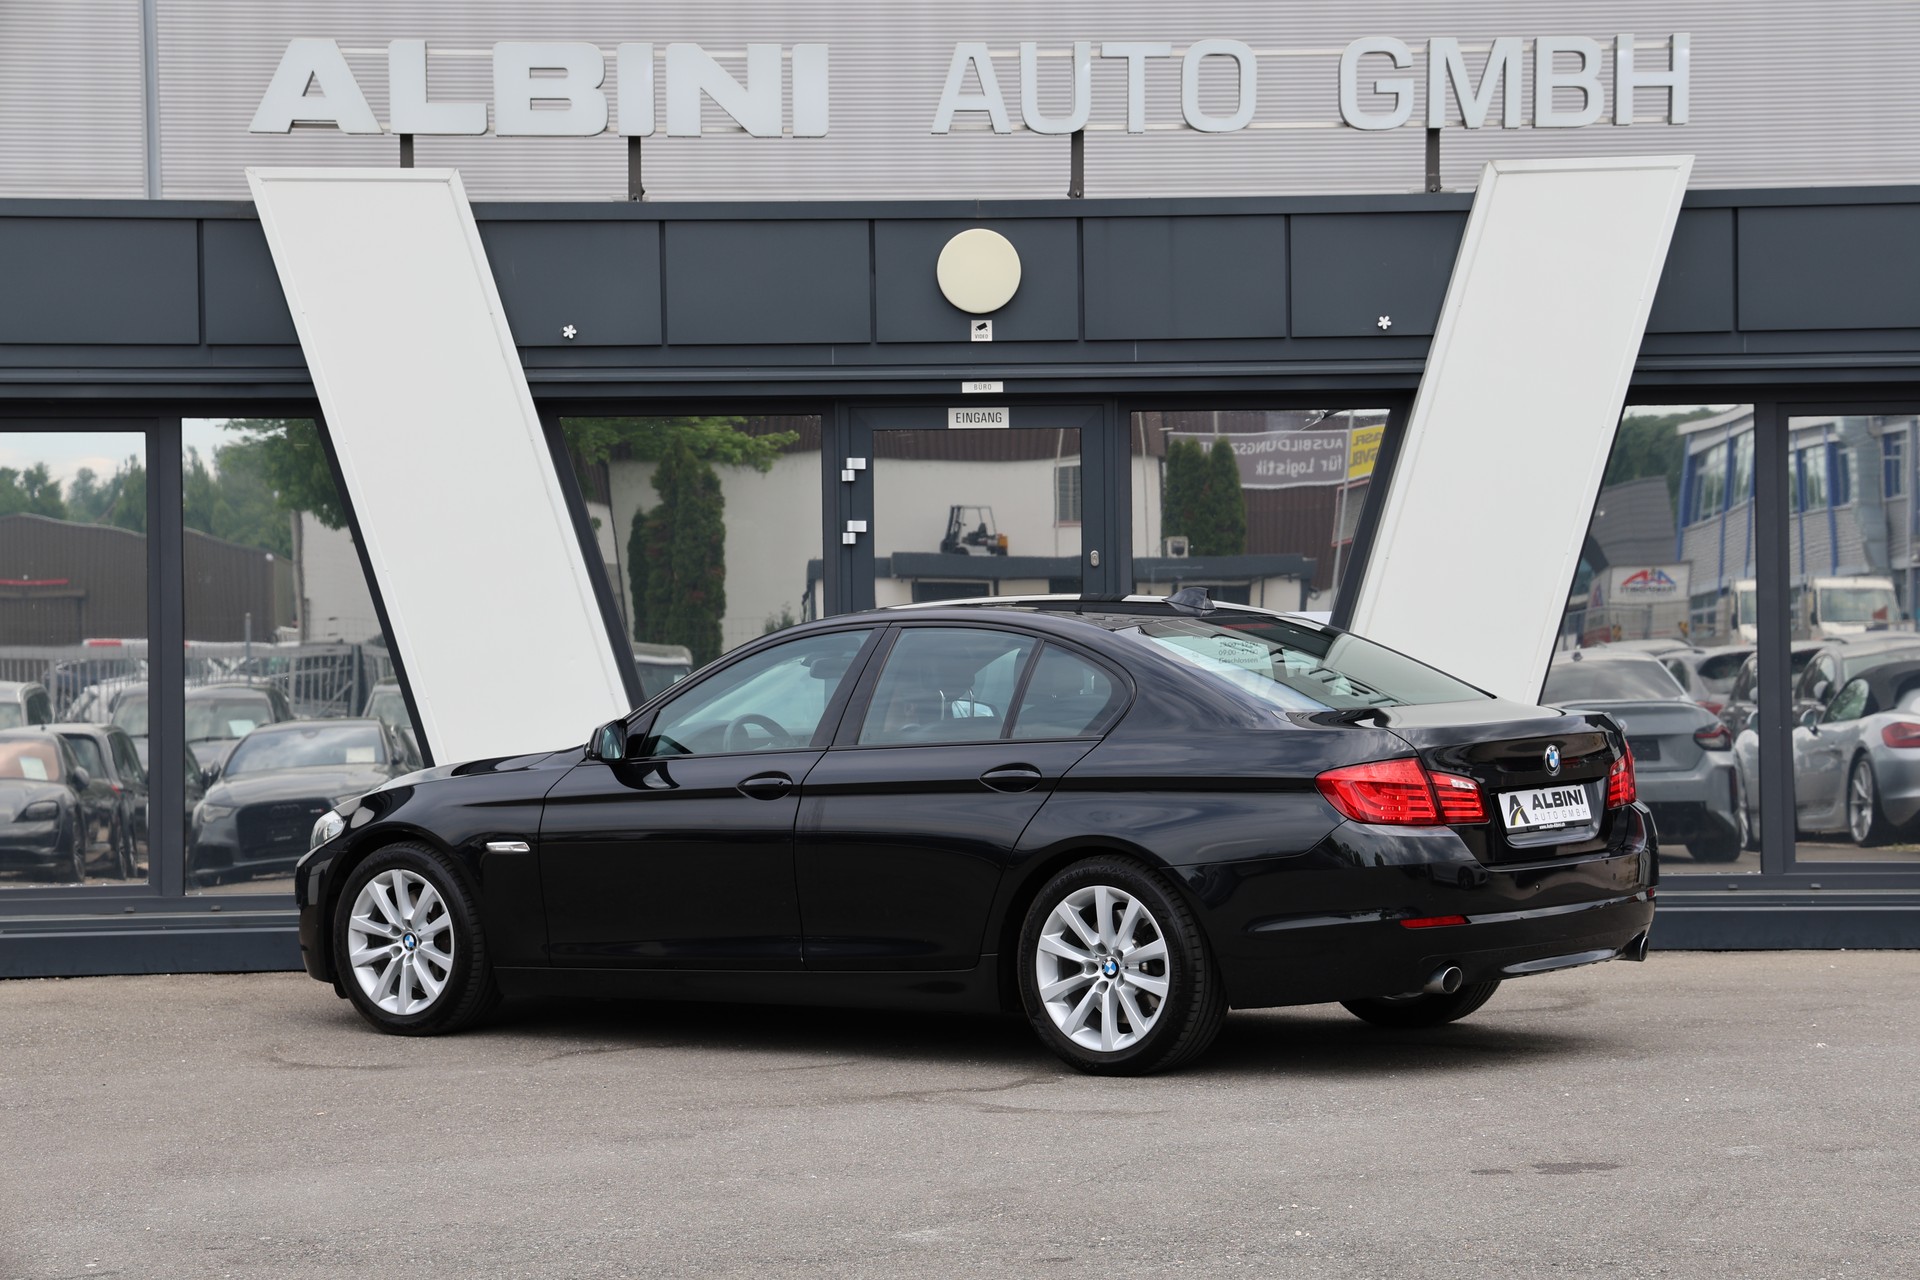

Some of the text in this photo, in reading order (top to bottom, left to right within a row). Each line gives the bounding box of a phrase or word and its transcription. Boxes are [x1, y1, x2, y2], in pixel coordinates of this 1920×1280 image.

[248, 32, 1690, 137] ALBINI AUTO GMBH
[973, 382, 992, 390] BÜRO
[955, 411, 1002, 424] EINGANG
[1532, 789, 1584, 810] ALBINI
[1534, 808, 1587, 822] AUTO GMBH
